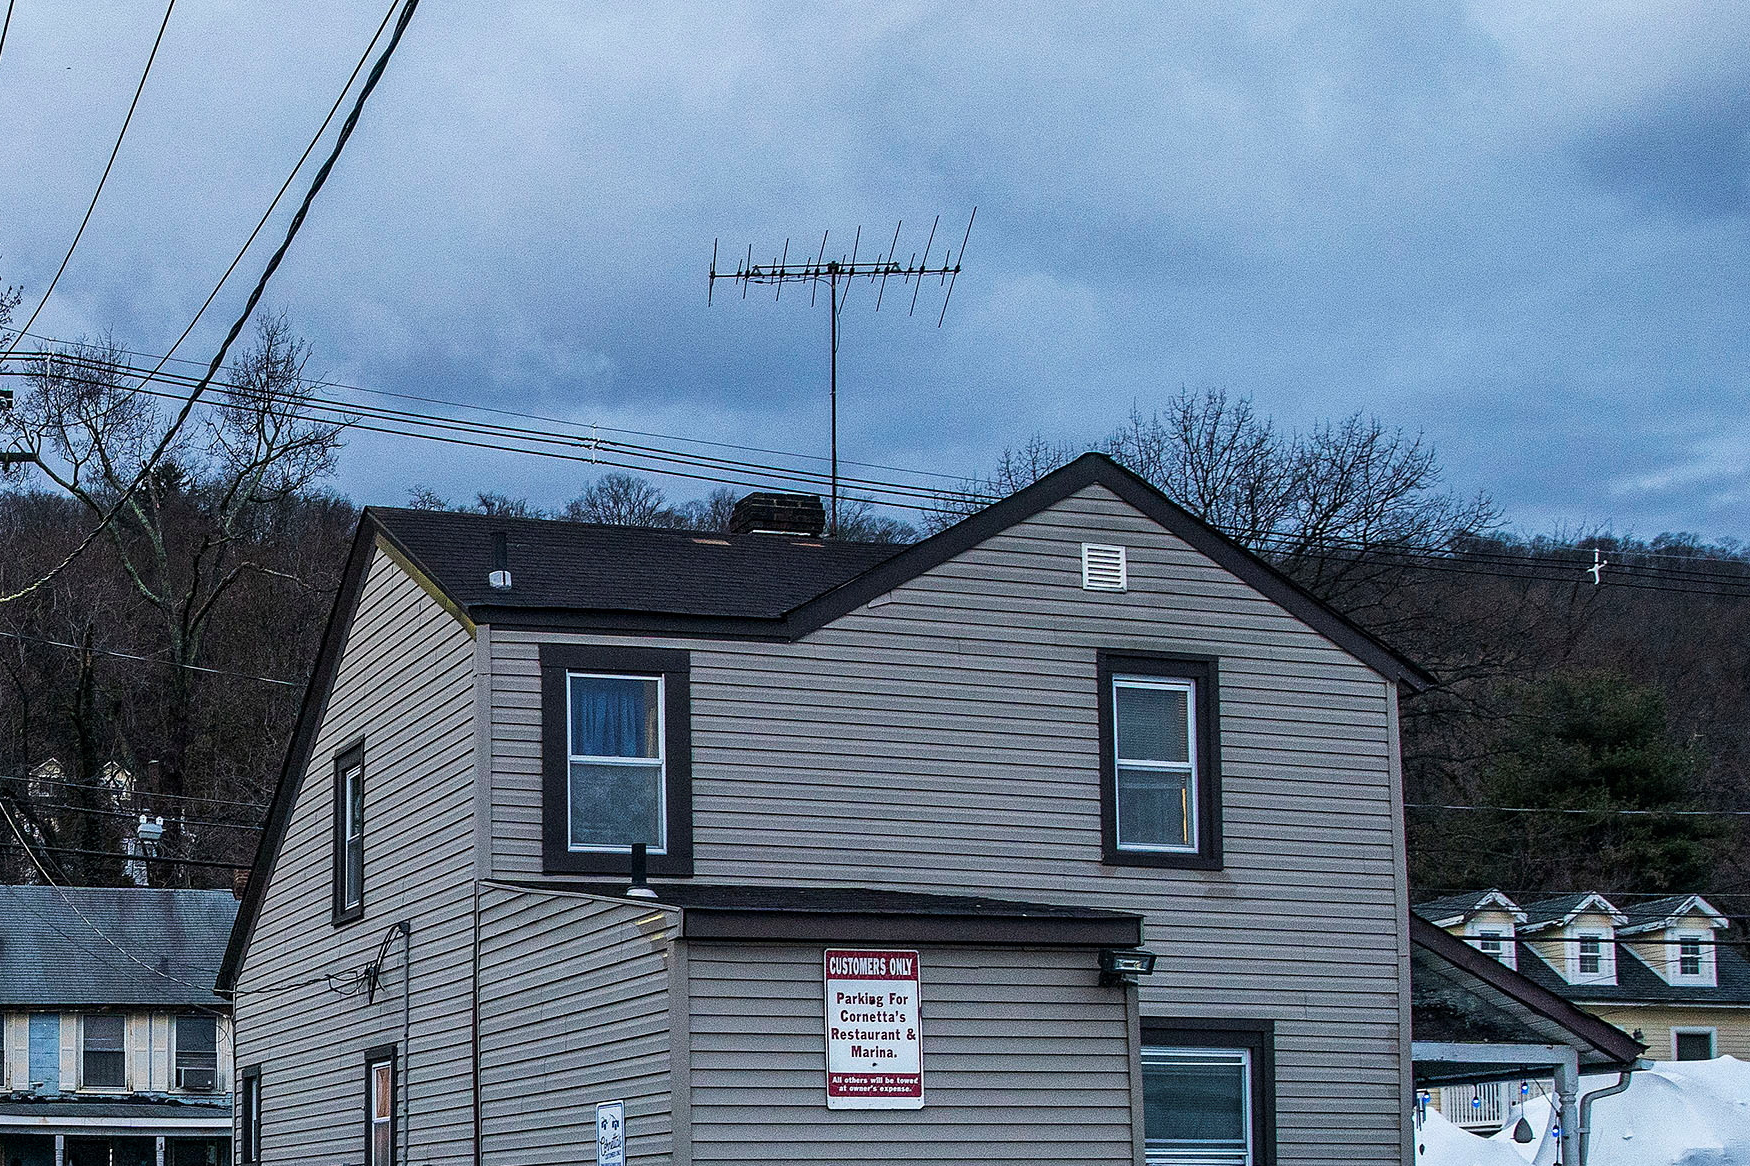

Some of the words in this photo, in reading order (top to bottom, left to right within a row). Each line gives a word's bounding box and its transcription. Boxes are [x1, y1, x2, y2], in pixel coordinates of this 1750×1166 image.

[829, 957, 886, 976] CUSTOMERS
[889, 958, 913, 976] ONLY
[836, 992, 884, 1008] Parking
[889, 992, 909, 1005] For
[840, 1010, 906, 1023] Cornetta's
[831, 1028, 901, 1040] Restaurant
[906, 1028, 916, 1040] &
[851, 1045, 898, 1058] Marina.
[832, 1076, 842, 1084] All
[844, 1076, 868, 1084] others
[896, 1077, 918, 1085] towed
[879, 1085, 912, 1093] expense.
